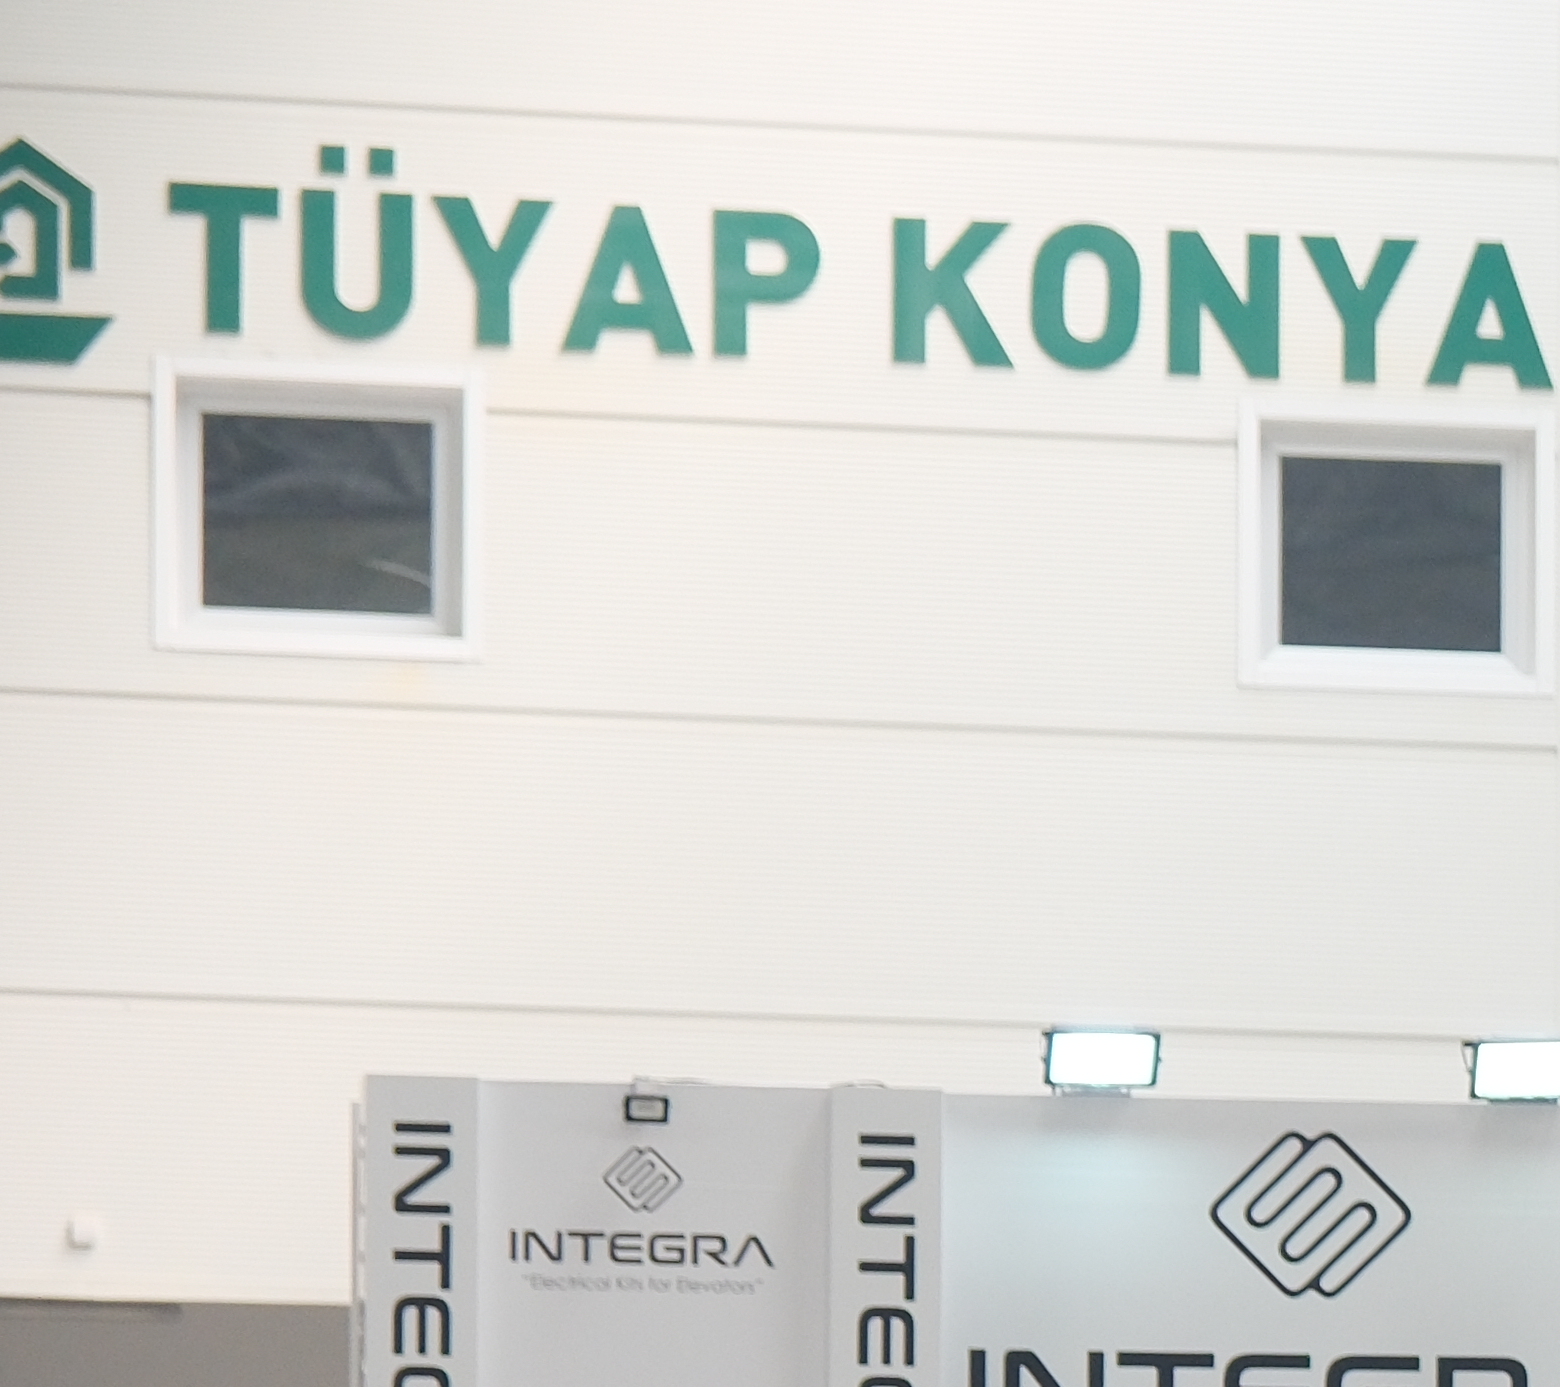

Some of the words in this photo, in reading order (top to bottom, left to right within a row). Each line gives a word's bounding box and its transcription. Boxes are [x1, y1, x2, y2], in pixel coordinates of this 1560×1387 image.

[166, 145, 820, 356] TÜYAP
[892, 218, 1553, 392] KONYA
[511, 1231, 773, 1267] INTEGRA
